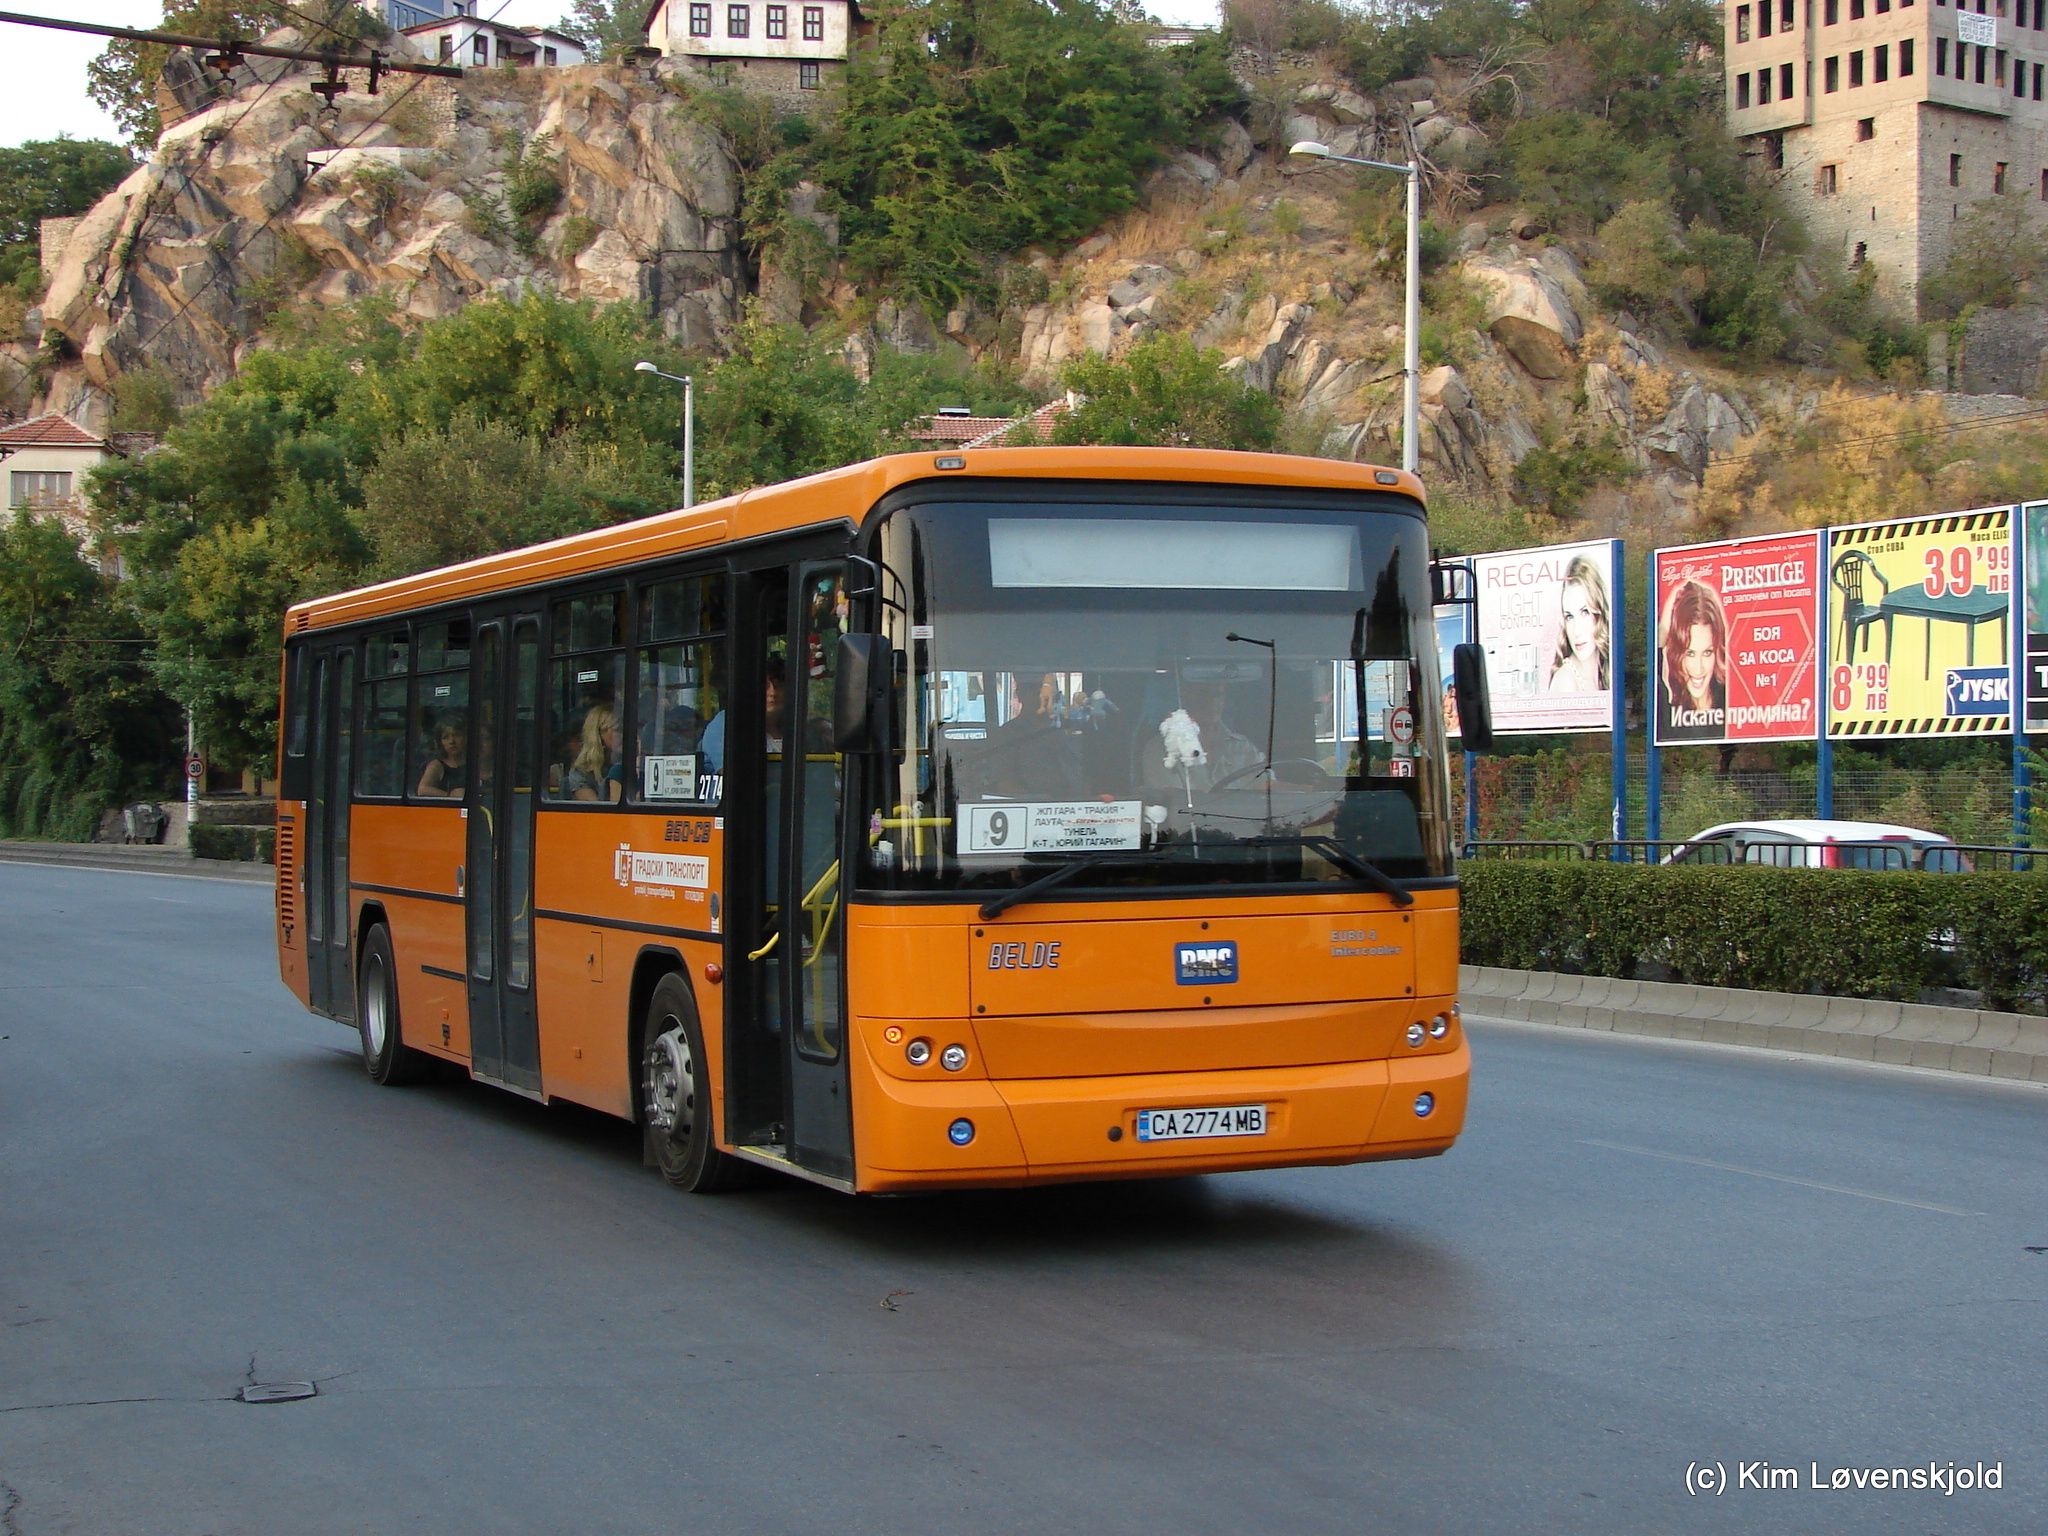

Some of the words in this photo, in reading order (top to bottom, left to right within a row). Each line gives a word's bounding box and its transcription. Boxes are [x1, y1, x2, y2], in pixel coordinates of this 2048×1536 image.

[1867, 545, 1883, 555] Стол
[1886, 541, 1904, 552] CUBA
[1971, 531, 1990, 542] Маса
[1487, 560, 1573, 589] REGAL
[1721, 560, 1806, 593] PRESTIGE
[1499, 590, 1544, 618] LIGHT
[1500, 614, 1544, 630] CONTROL
[1753, 626, 1781, 642] БОЯ
[1739, 652, 1756, 666] ЗА
[1759, 649, 1795, 664] КОСА
[1755, 673, 1777, 688] №1
[1958, 678, 2009, 703] JYSK
[1670, 705, 1725, 728] Искате
[1727, 697, 1812, 730] промяна?
[190, 764, 201, 773] 30
[652, 762, 660, 793] 9
[698, 774, 725, 801] 2774
[1036, 807, 1053, 816] ЖП
[1054, 806, 1076, 816] ГАРА
[989, 811, 1009, 847] 9
[1063, 827, 1098, 837] ТУНЕЛА
[635, 858, 664, 879] ГРАДСКИ
[665, 861, 705, 881] ТРАНСПОРТ
[1330, 929, 1365, 943] EURO
[988, 941, 1062, 970] BELDE
[1180, 947, 1234, 978] BMC
[1152, 1113, 1178, 1136] CA
[1182, 1111, 1232, 1135] 2774
[1235, 1109, 1262, 1132] MB
